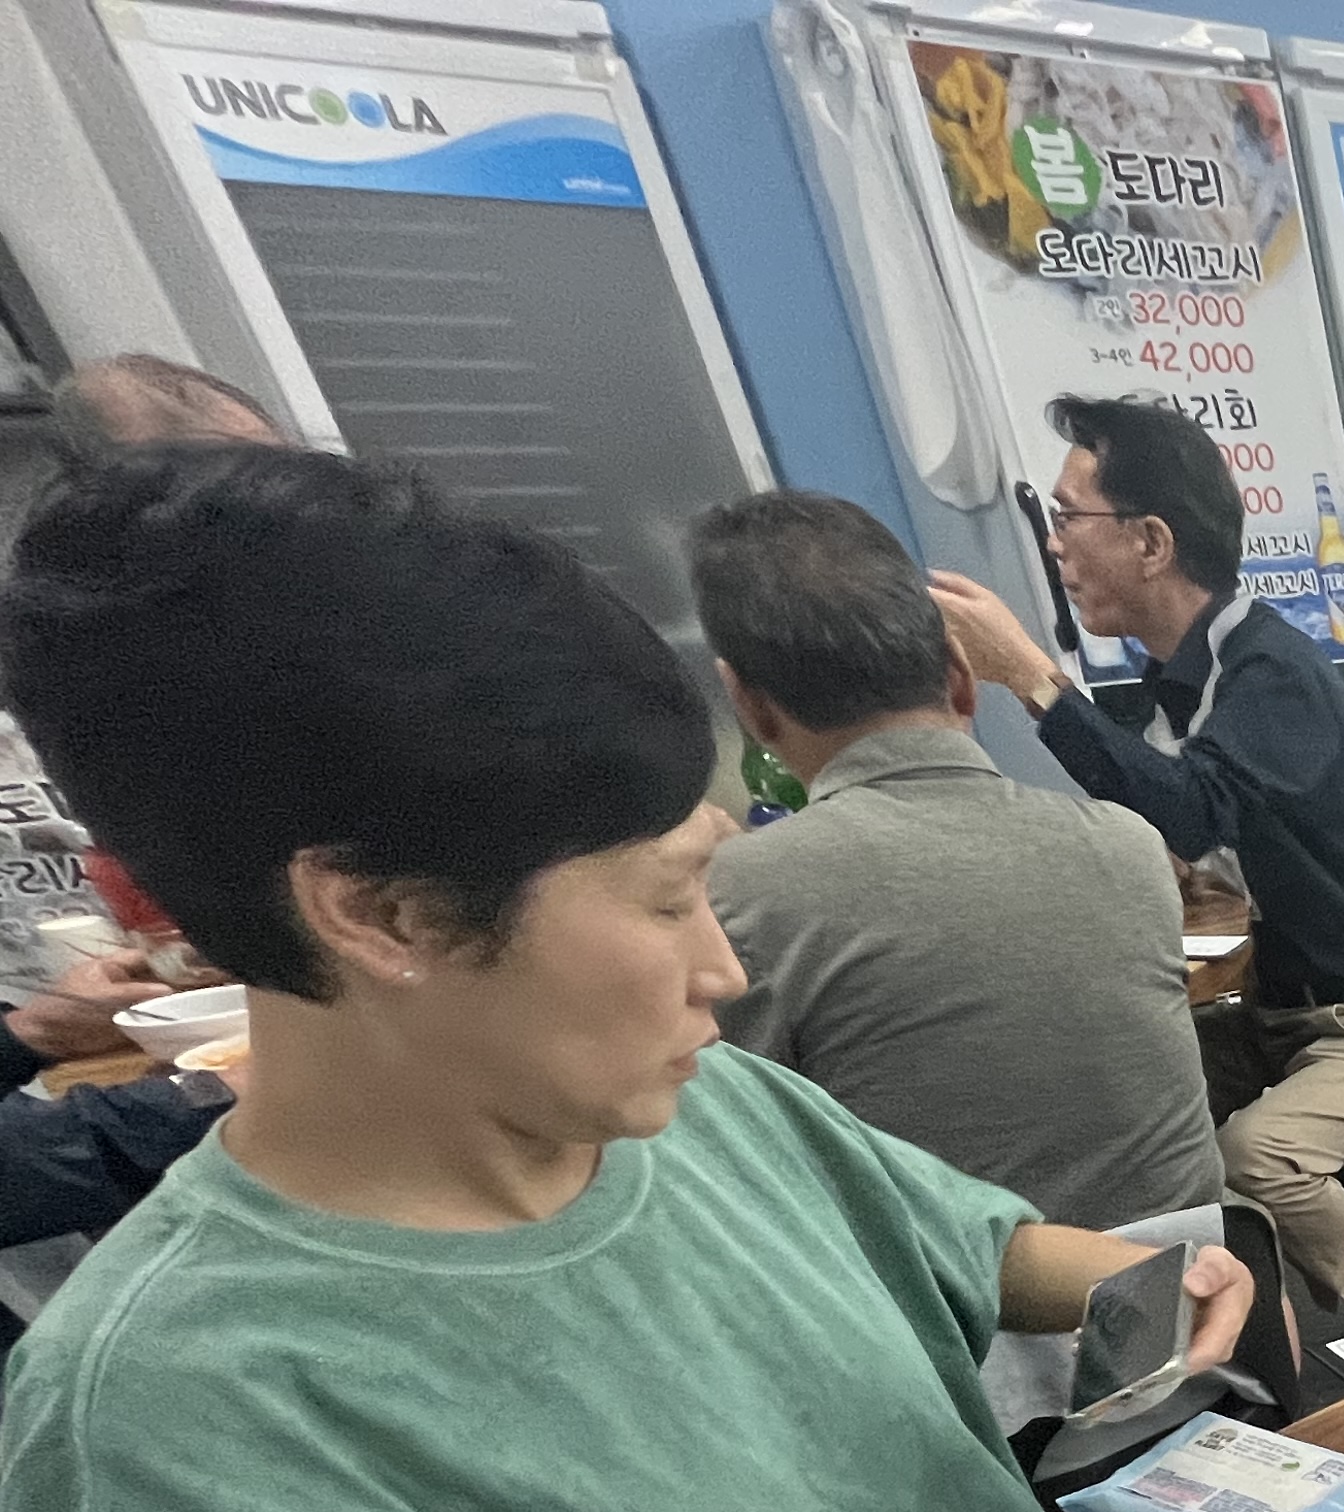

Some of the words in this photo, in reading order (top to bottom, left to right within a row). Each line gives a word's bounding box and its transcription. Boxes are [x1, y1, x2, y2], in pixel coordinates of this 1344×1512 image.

[1028, 126, 1087, 205] 봄
[1108, 152, 1225, 208] 도다리
[1040, 231, 1261, 283] 도다리세꼬시
[1129, 293, 1245, 335] 32,000
[1140, 340, 1255, 382] 42,000
